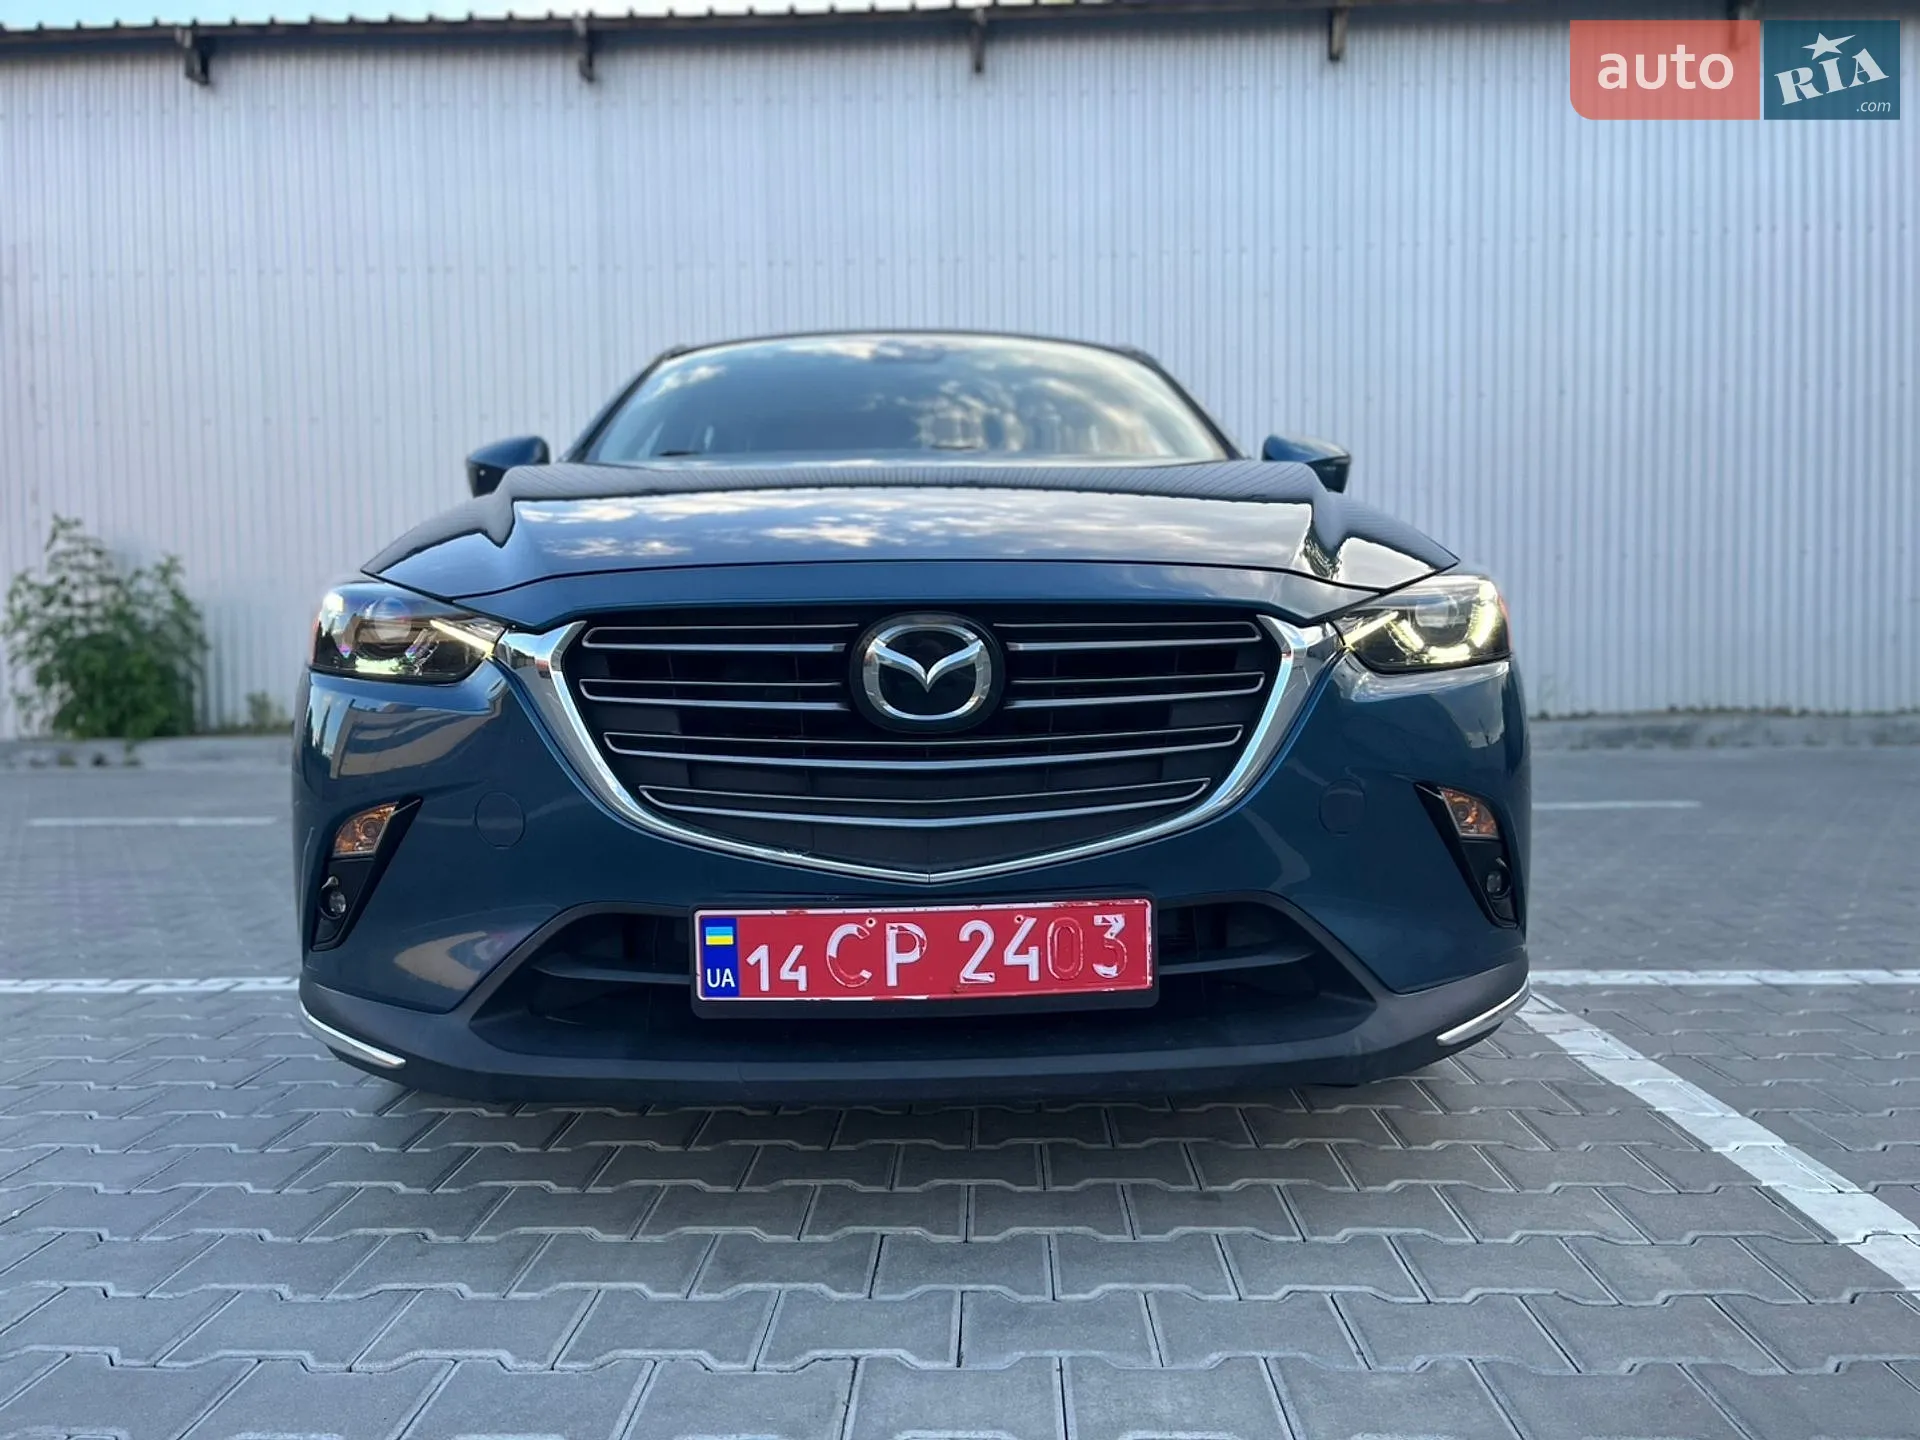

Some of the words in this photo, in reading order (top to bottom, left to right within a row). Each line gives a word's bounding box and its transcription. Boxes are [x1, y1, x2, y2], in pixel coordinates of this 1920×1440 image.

[746, 944, 807, 992] 14
[826, 923, 927, 987] CP
[958, 914, 1127, 984] 2403
[706, 968, 736, 988] UA
